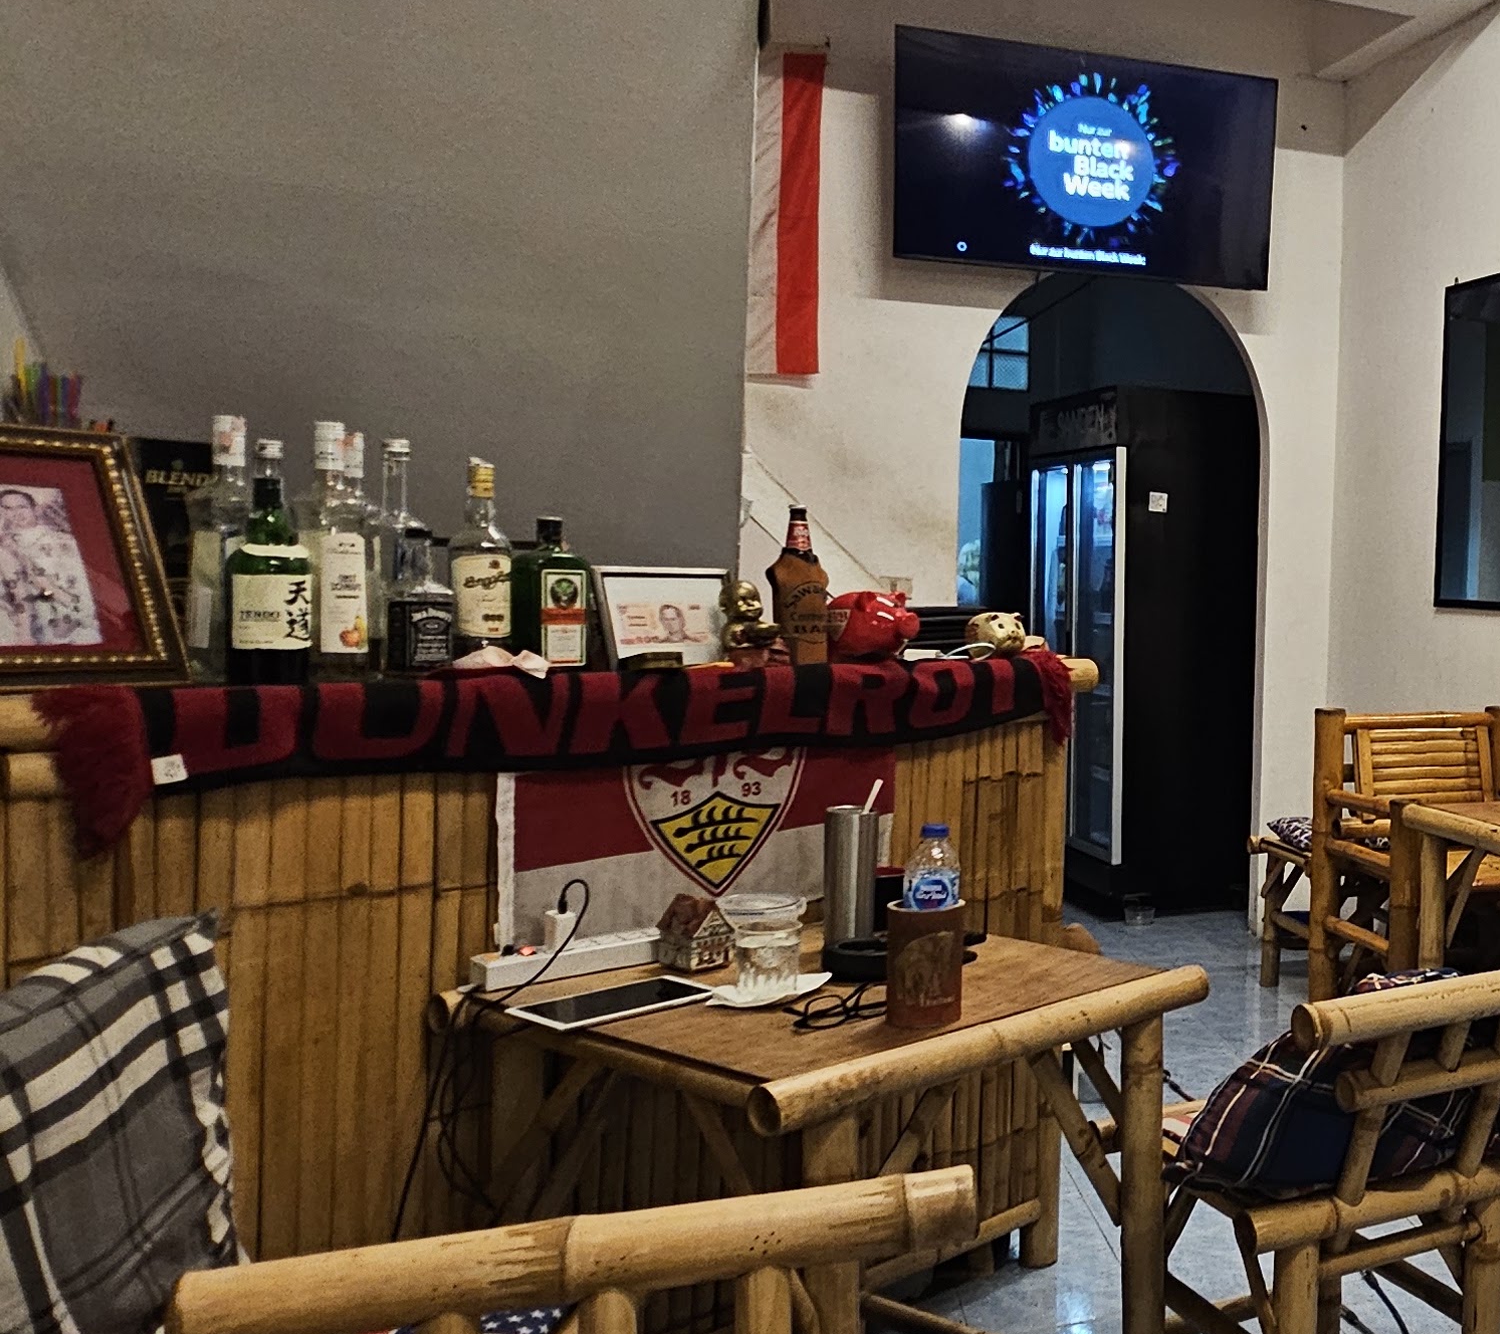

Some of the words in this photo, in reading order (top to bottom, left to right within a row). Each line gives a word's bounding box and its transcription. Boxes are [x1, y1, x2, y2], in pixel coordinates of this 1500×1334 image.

[1049, 129, 1131, 160] bunten
[1073, 154, 1134, 182] Black
[1063, 172, 1131, 202] Week
[670, 789, 692, 807] 18
[740, 780, 762, 798] 93
